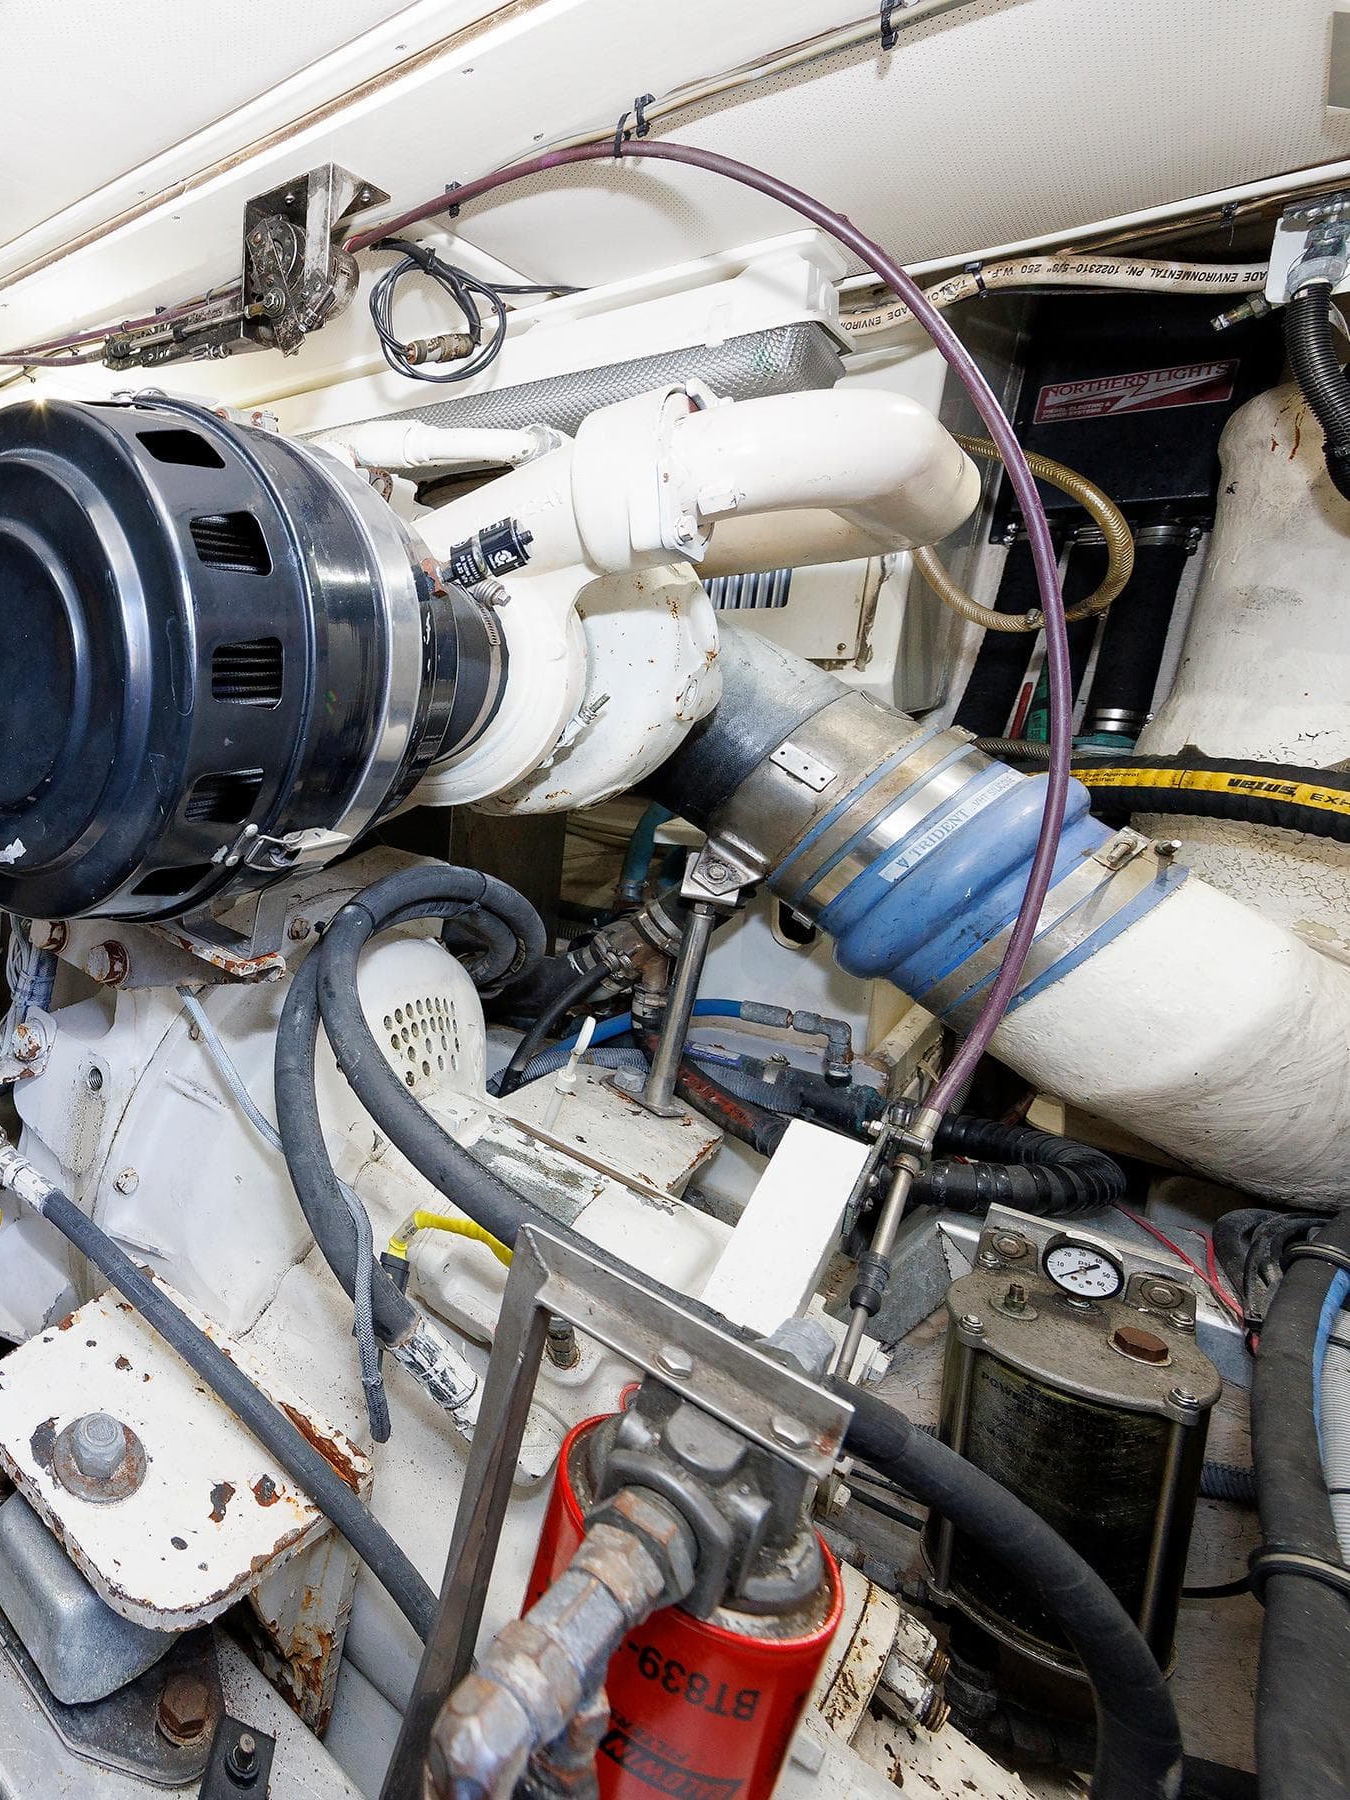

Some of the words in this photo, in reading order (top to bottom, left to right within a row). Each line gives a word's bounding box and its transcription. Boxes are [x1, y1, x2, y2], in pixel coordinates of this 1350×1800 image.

[1020, 263, 1040, 274] 250
[1124, 267, 1146, 280] PN:
[1150, 266, 1238, 284] ENVIRONMENTAL
[1247, 269, 1267, 282] ADE
[887, 304, 909, 320] ADE
[1048, 372, 1150, 398] NORTHERN
[1154, 363, 1230, 383] LIGHTS
[910, 810, 969, 857] TRIDENT
[1063, 1250, 1072, 1258] 20
[1079, 1250, 1087, 1258] 30
[1056, 1260, 1065, 1268] 10
[1096, 1280, 1105, 1288] 60
[618, 1639, 761, 1722] BT839-
